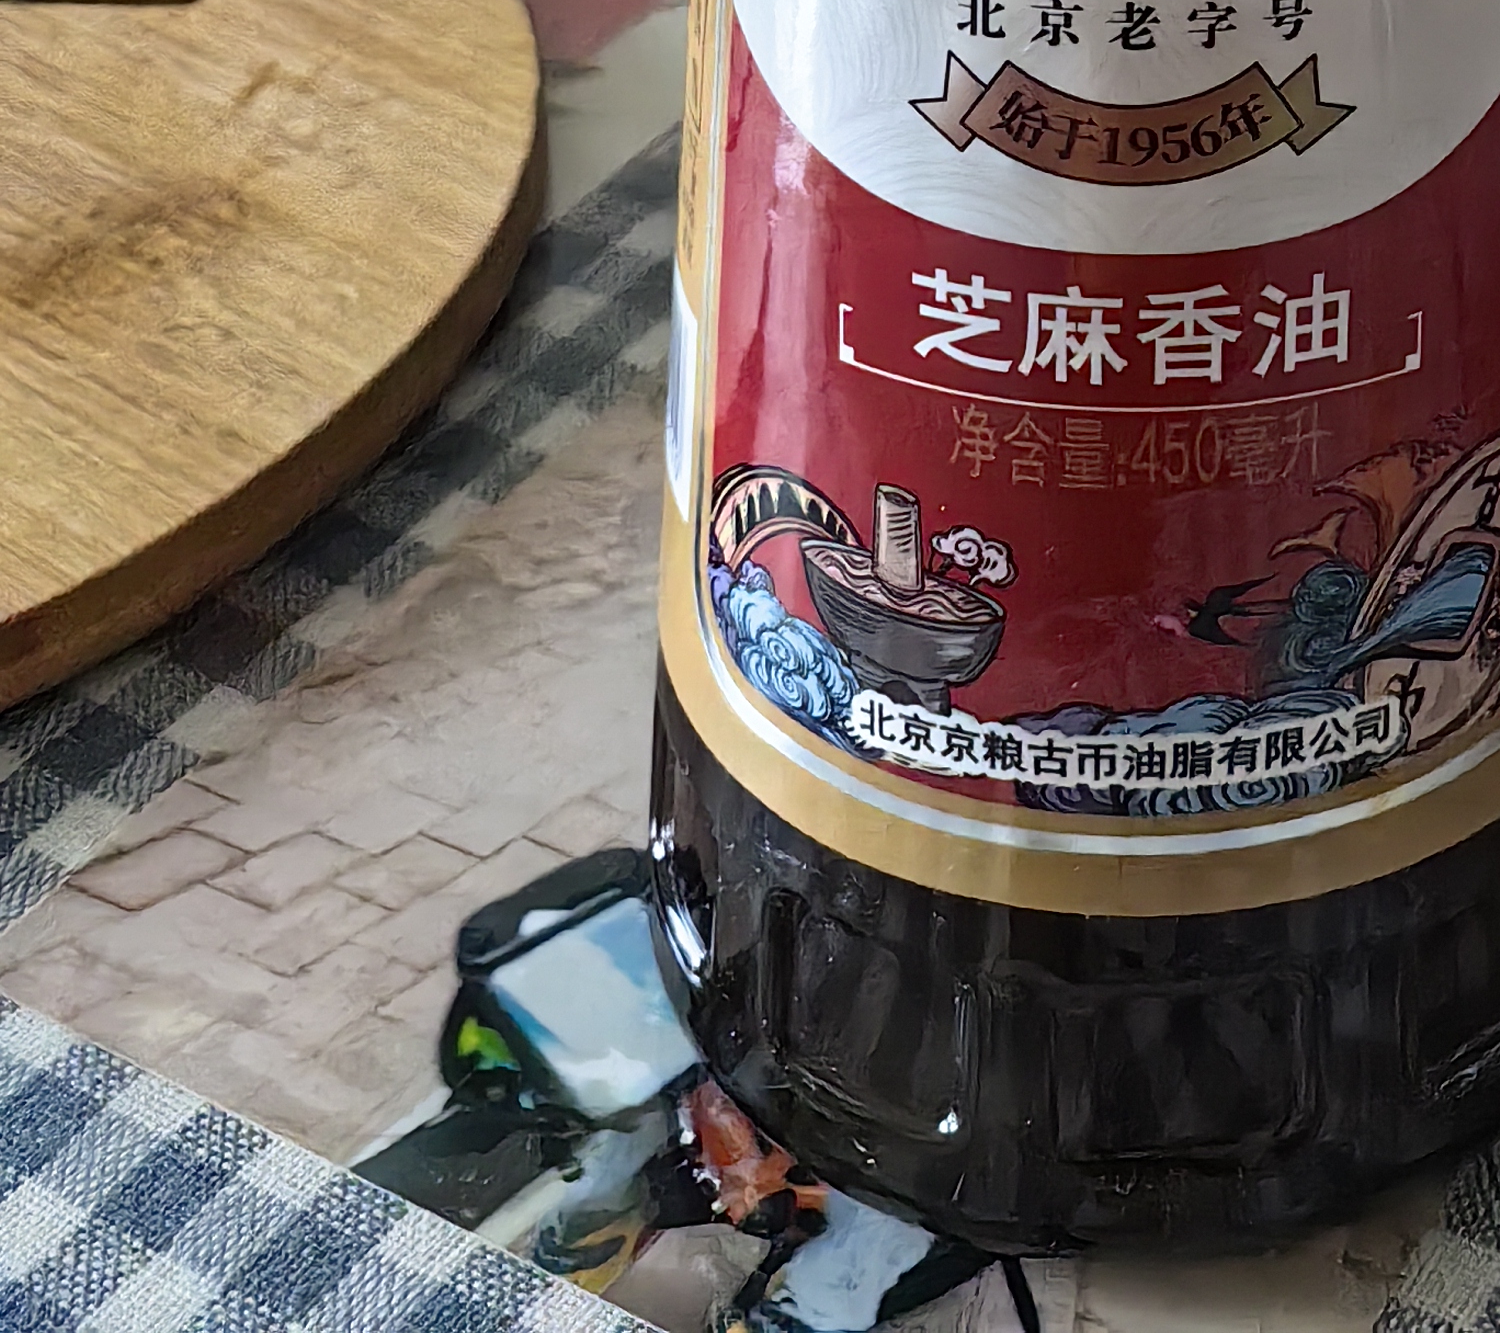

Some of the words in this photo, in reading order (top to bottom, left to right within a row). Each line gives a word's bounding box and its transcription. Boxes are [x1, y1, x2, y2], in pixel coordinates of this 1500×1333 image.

[989, 89, 1273, 167] 始于1956年
[911, 267, 1352, 387] 芝麻香油
[857, 697, 1393, 782] 北京京粮古币油脂有限公司
